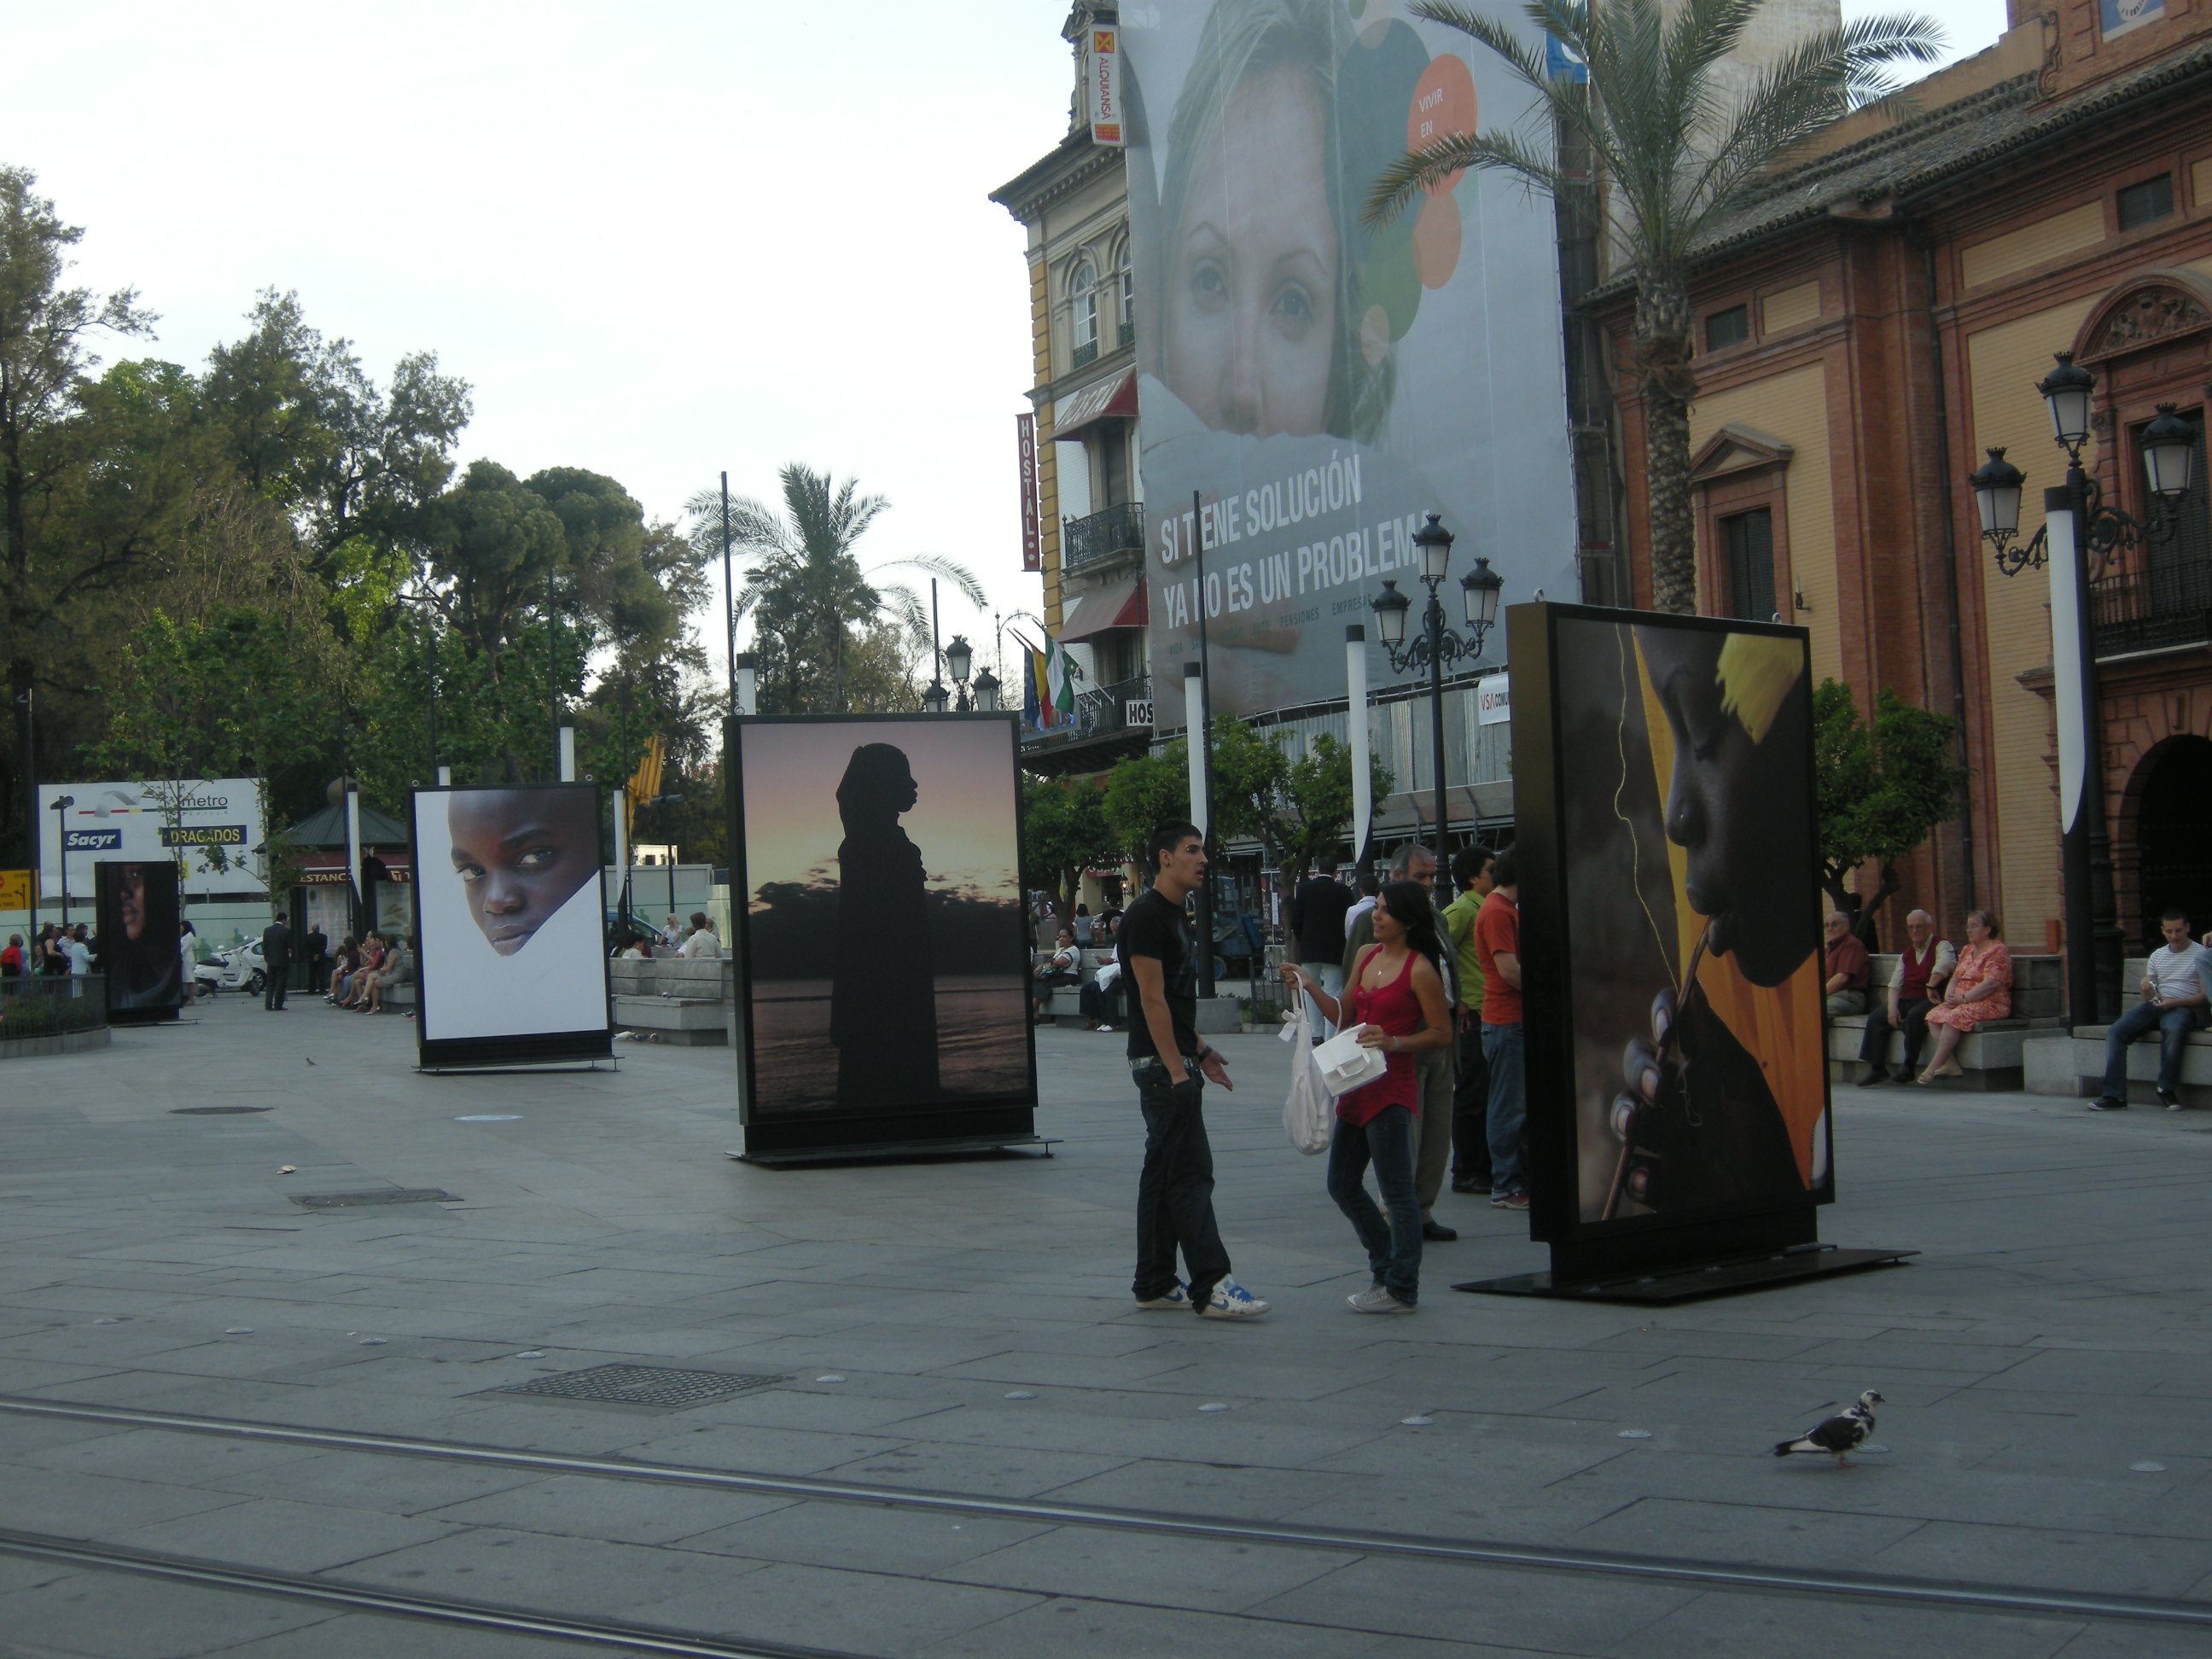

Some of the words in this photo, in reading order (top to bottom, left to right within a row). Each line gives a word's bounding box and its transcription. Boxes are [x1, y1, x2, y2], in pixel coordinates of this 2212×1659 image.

[1099, 56, 1111, 119] ALQUIANSA
[1418, 88, 1443, 113] VIVIR
[1421, 119, 1433, 137] EN
[1021, 420, 1035, 535] HOSTAL
[1161, 517, 1179, 564] SI
[1183, 495, 1241, 556] TENE
[1246, 449, 1362, 537] SOLUCIÓN
[1164, 582, 1189, 629] YA
[1227, 562, 1254, 614] ES
[1260, 551, 1291, 604] UN
[181, 795, 228, 806] metro
[67, 832, 116, 848] Sacyr
